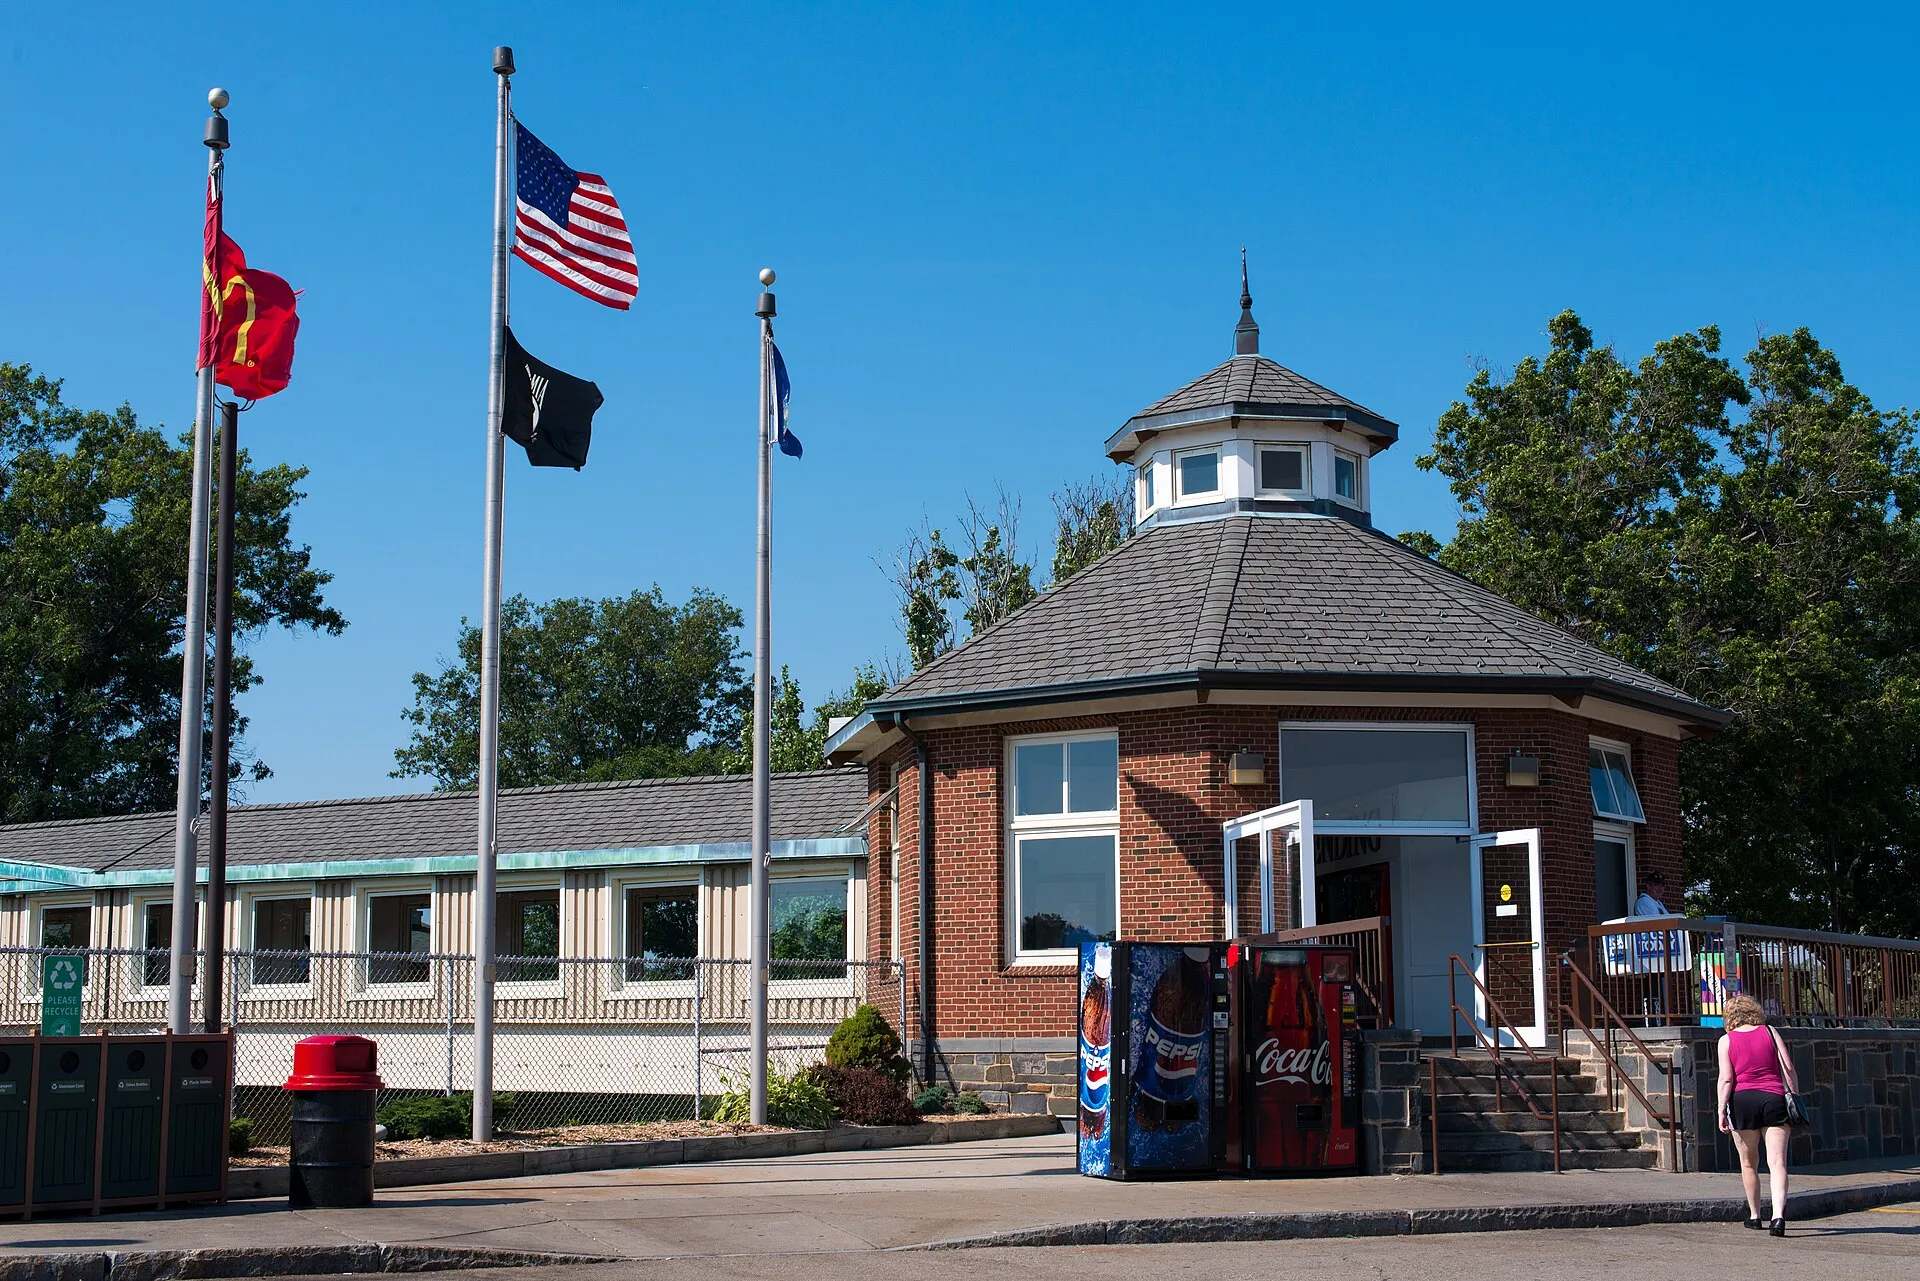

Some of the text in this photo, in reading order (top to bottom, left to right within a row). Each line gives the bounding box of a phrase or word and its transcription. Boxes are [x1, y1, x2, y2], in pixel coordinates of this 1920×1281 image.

[44, 1007, 79, 1016] RECYCLE
[47, 996, 77, 1005] PLEASE
[1080, 1043, 1110, 1071] PEPS
[1145, 1027, 1203, 1060] PEPSI
[1256, 1038, 1333, 1085] Coca-Co
